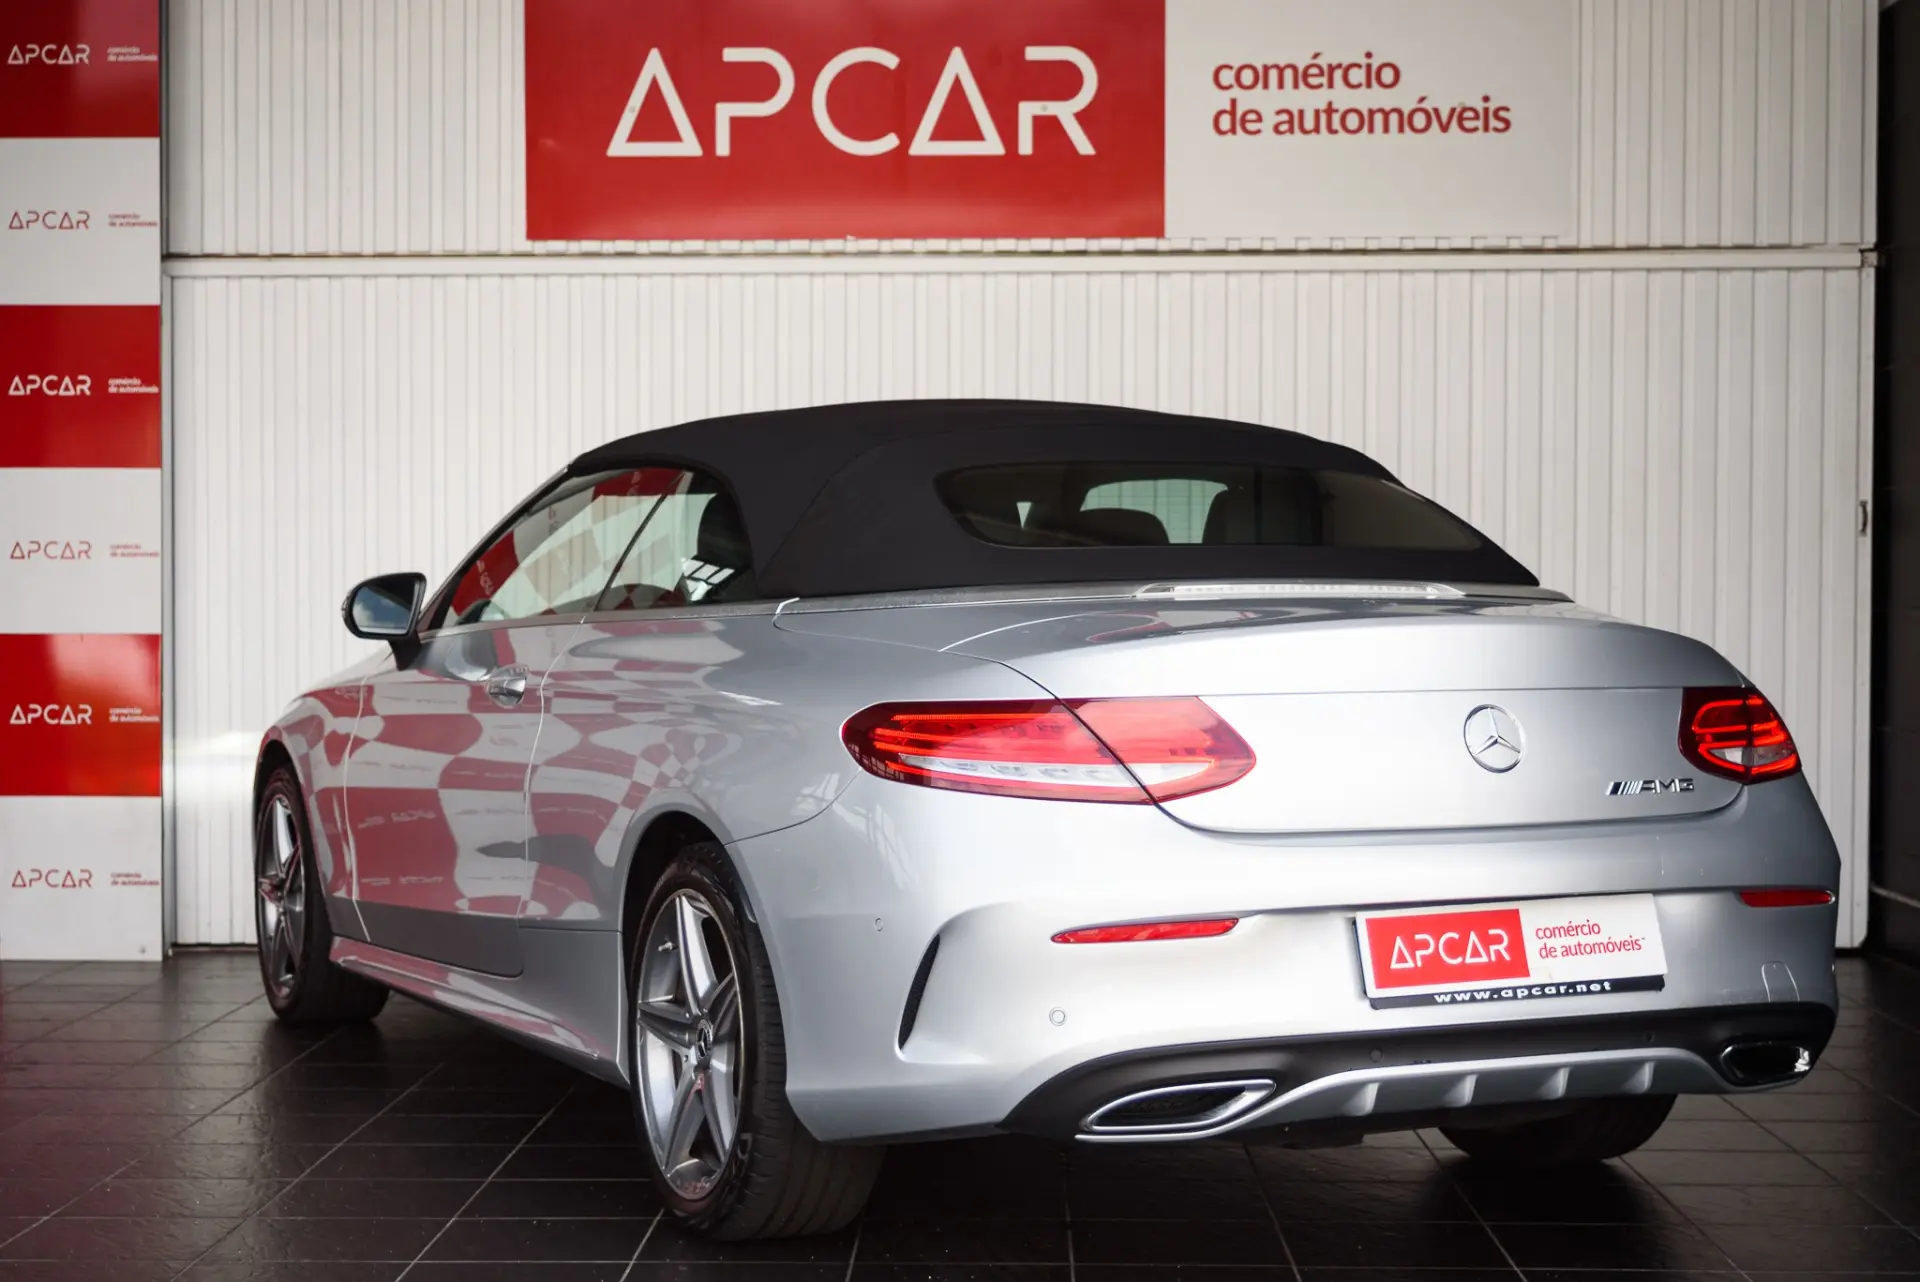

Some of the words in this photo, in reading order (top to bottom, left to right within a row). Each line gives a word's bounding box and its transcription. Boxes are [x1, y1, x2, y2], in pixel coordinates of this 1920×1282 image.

[7, 44, 91, 65] APCAR
[1212, 52, 1401, 91] comércio
[606, 45, 1098, 158] APCAR
[1212, 97, 1263, 136] de
[1272, 95, 1512, 136] automóveis
[8, 210, 91, 230] APCAR
[8, 374, 92, 396] APCAR
[10, 540, 92, 560] APCAR
[10, 703, 93, 725] APCAR
[11, 868, 93, 889] APCAR
[1535, 919, 1602, 940] comércio
[1389, 928, 1512, 970] APCAR
[1539, 942, 1558, 960] de
[1560, 935, 1643, 958] automóveis
[1433, 980, 1613, 1004] www.apcar.net
